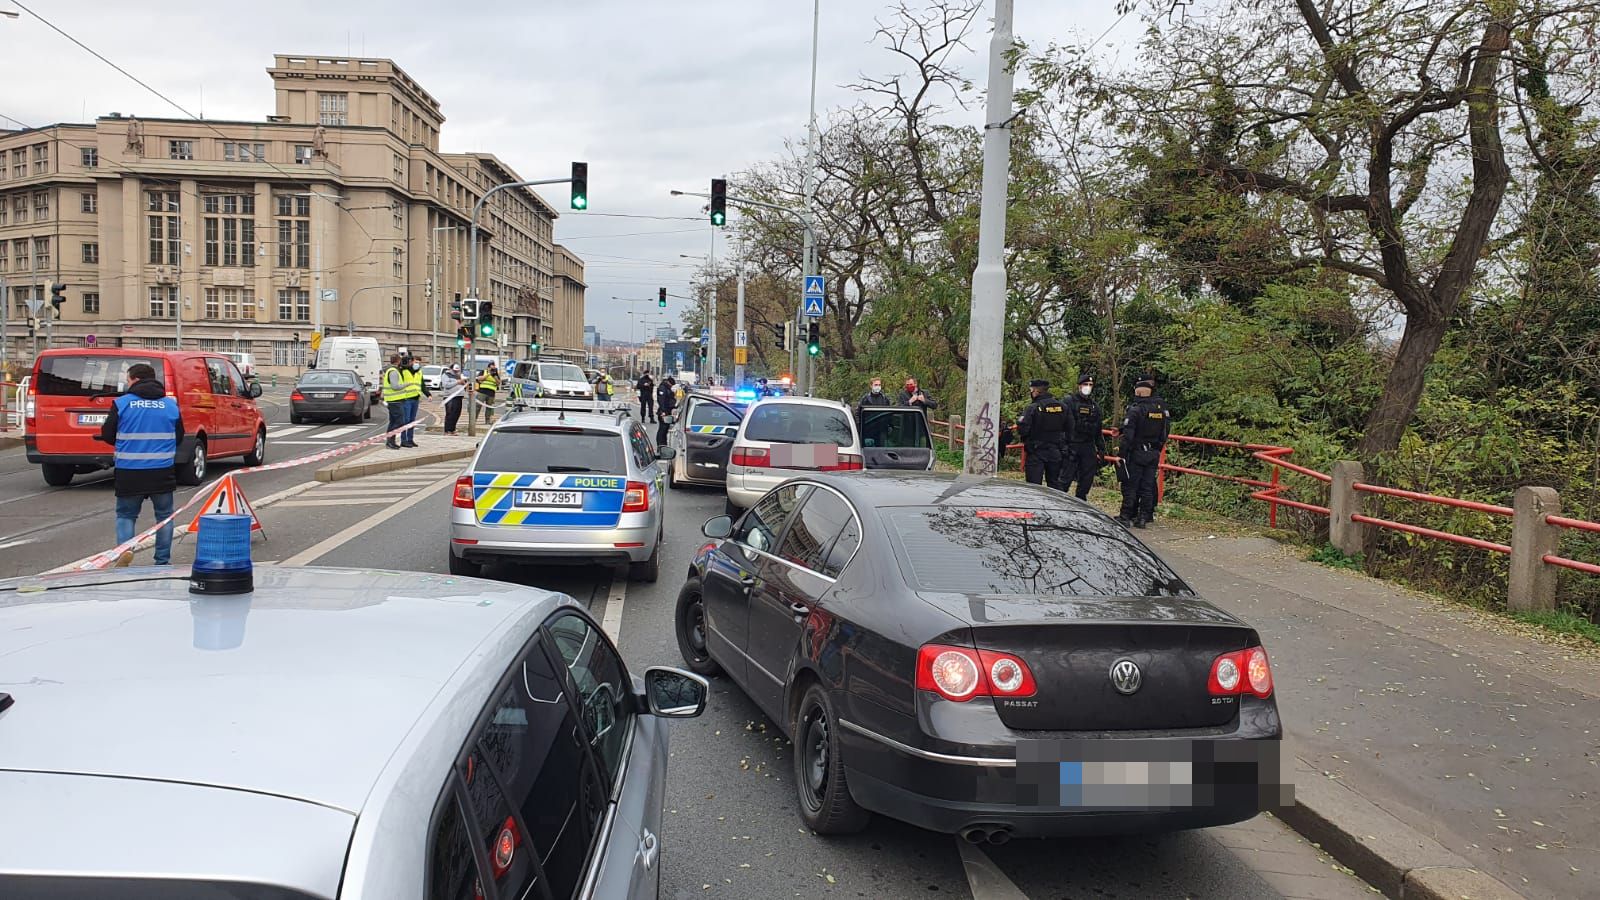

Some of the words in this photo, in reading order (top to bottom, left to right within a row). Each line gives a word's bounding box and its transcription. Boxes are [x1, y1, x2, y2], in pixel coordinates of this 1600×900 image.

[130, 401, 166, 409] PRESS
[575, 478, 618, 488] POLICIE
[524, 492, 544, 503] 7AS
[551, 493, 577, 503] 2951
